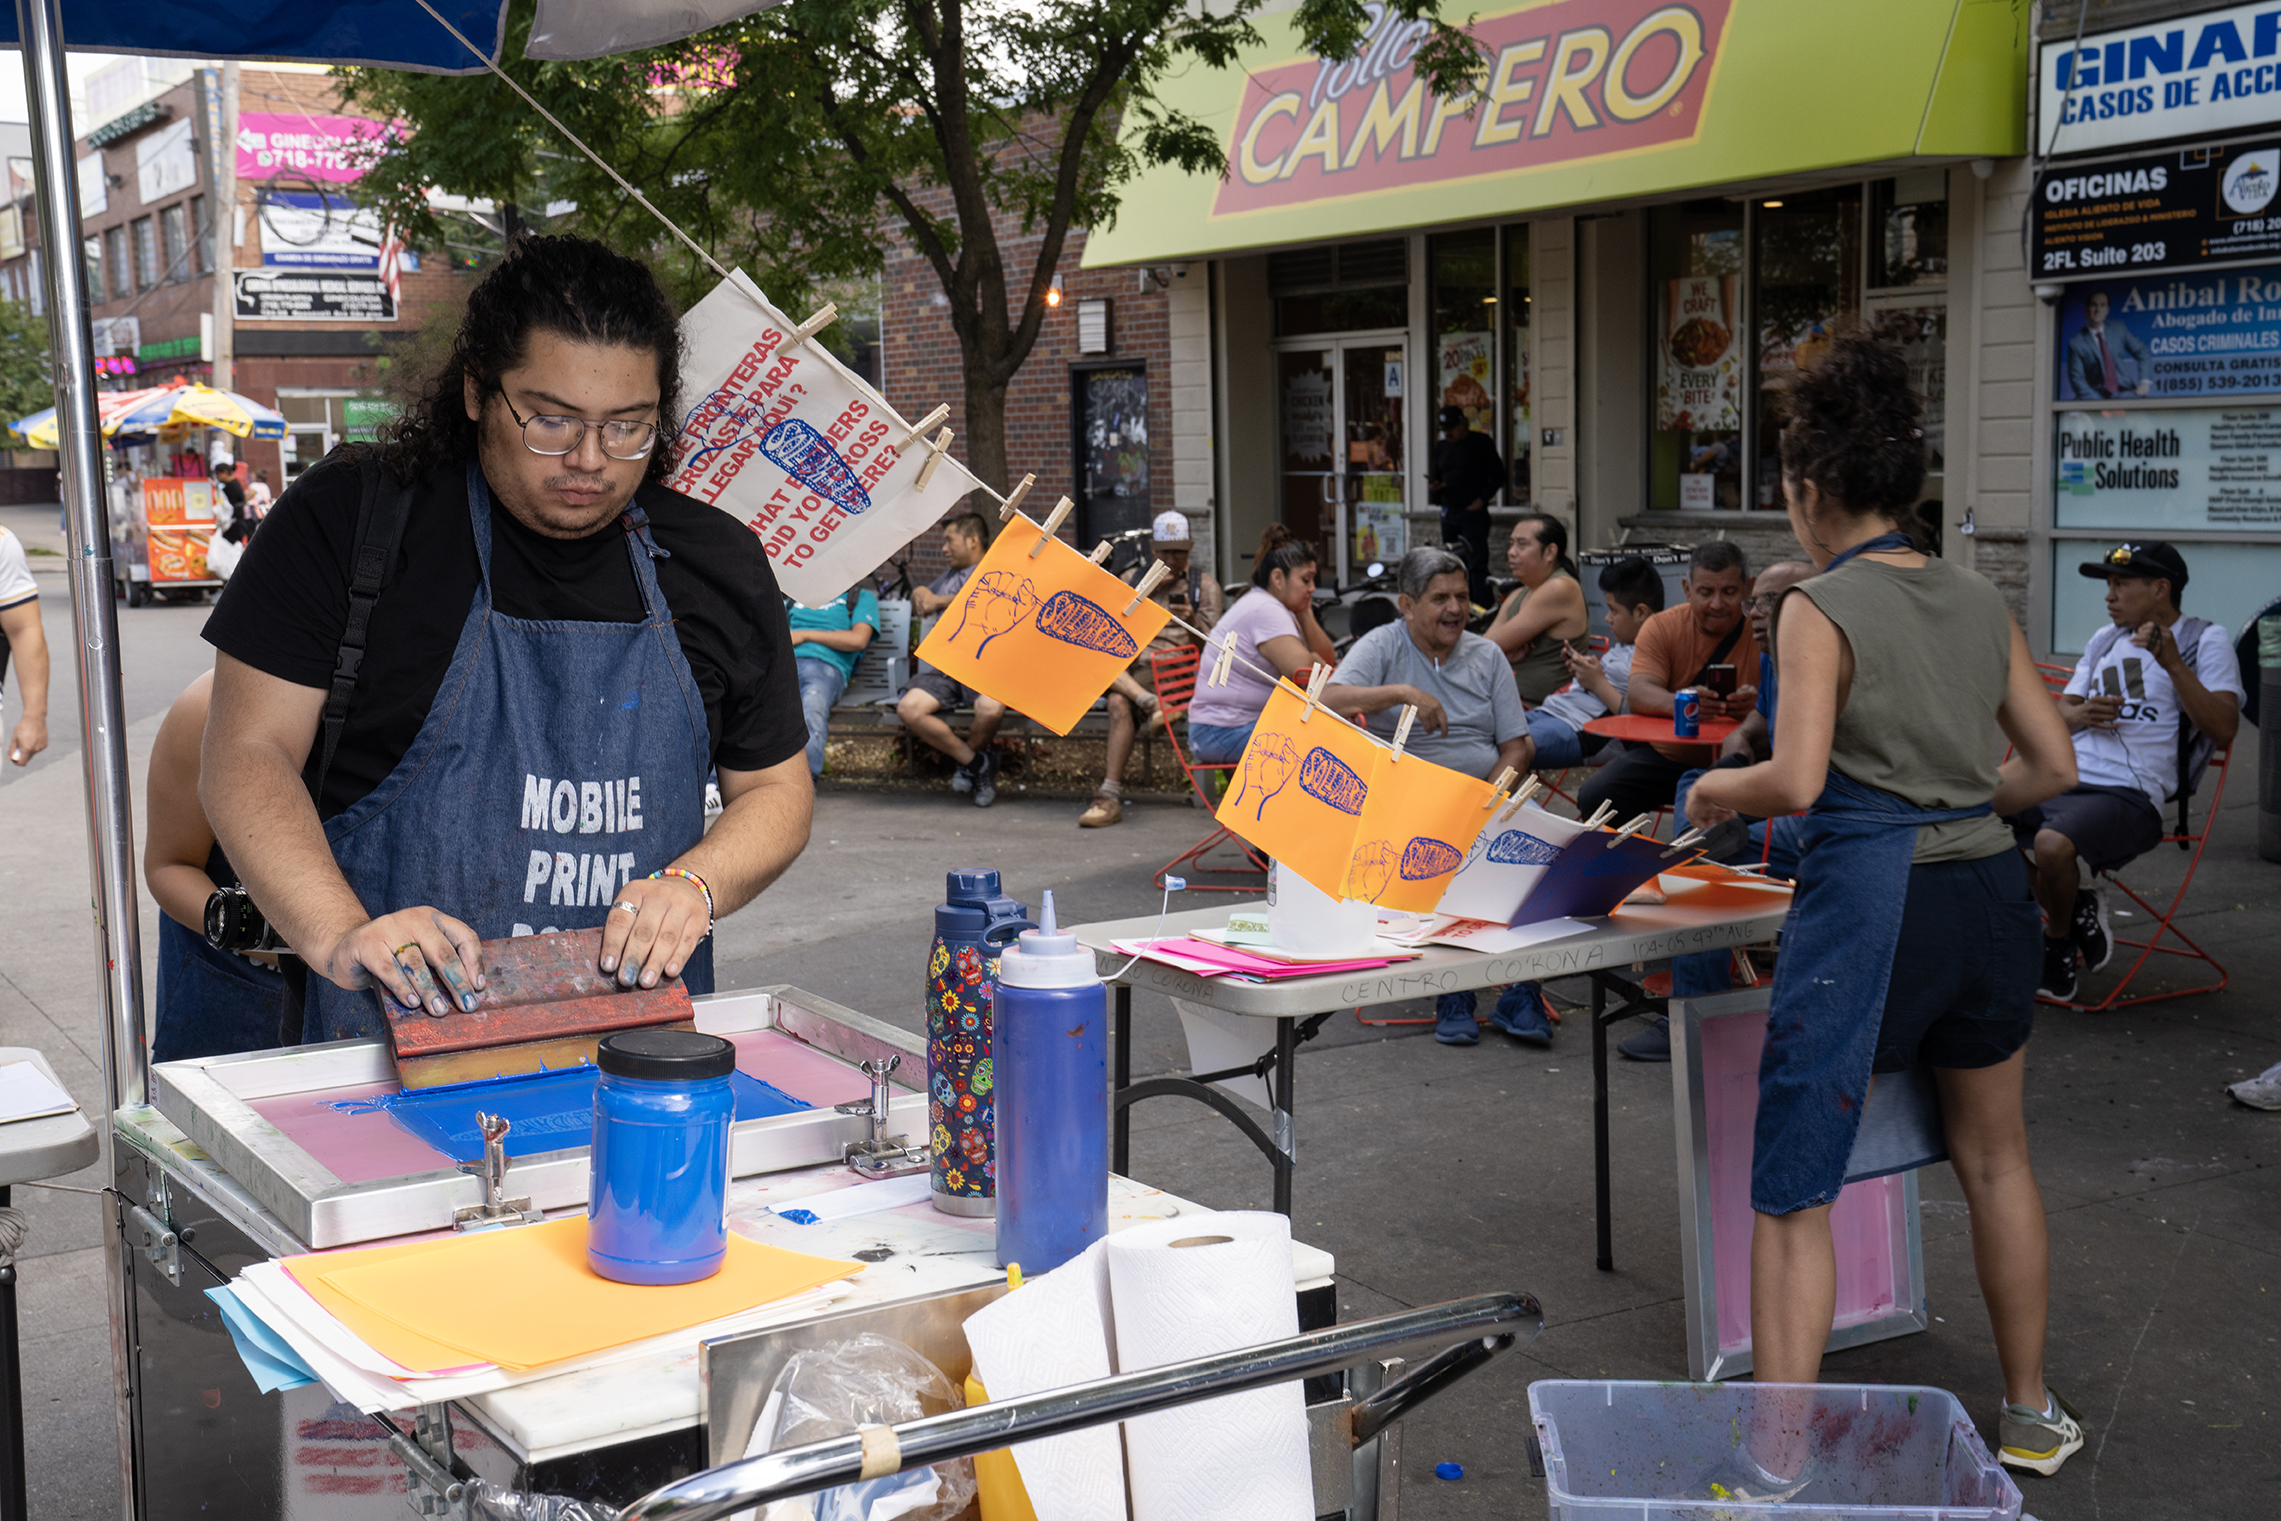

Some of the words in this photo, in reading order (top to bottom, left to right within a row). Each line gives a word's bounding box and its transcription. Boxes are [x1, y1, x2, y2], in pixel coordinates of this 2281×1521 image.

[1239, 3, 1708, 187] CAMPERO
[2061, 86, 2153, 126] CASOS
[2164, 77, 2200, 110] DE
[2045, 166, 2168, 203] OFICINAS
[2080, 202, 2121, 215] ALIENTO
[2122, 200, 2136, 211] DE
[2137, 198, 2161, 209] VIDA
[2233, 217, 2265, 235] (718)
[2043, 250, 2077, 271] 2FL
[2080, 247, 2128, 268] Suite
[2131, 241, 2166, 263] 203
[2121, 280, 2225, 312] Anibal
[2151, 309, 2228, 331] Abogado
[2231, 308, 2253, 324] de
[2151, 336, 2196, 355] CASOS
[2198, 331, 2279, 352] CRIMINALES
[1680, 369, 1719, 389] EVERY
[2154, 360, 2225, 374] CONSULTA
[2230, 356, 2281, 371] GRATIS
[684, 327, 783, 440] FRONTERAS
[1683, 389, 1711, 405] BITE
[2155, 376, 2202, 392] 1(855)
[2208, 373, 2281, 390] 539-2013
[671, 409, 751, 495] CRUZASTE
[747, 356, 800, 408] PARA
[2061, 431, 2114, 459] Public
[2120, 428, 2180, 458] Health
[2095, 461, 2179, 489] Solutions
[746, 488, 791, 538] HAT
[762, 525, 797, 559] DID
[782, 543, 815, 569] TO
[809, 503, 848, 543] GET
[1301, 749, 1366, 813] SOLIDARI
[521, 773, 643, 834] MOBILE
[524, 850, 636, 907] PRINT
[1099, 957, 1143, 980] NTRO
[1151, 968, 1214, 1000] CORONA
[1342, 970, 1458, 1004] CENTRO
[1485, 944, 1604, 984] CORONA
[1632, 934, 1685, 959] 104-05
[1726, 920, 1754, 940] AVE
